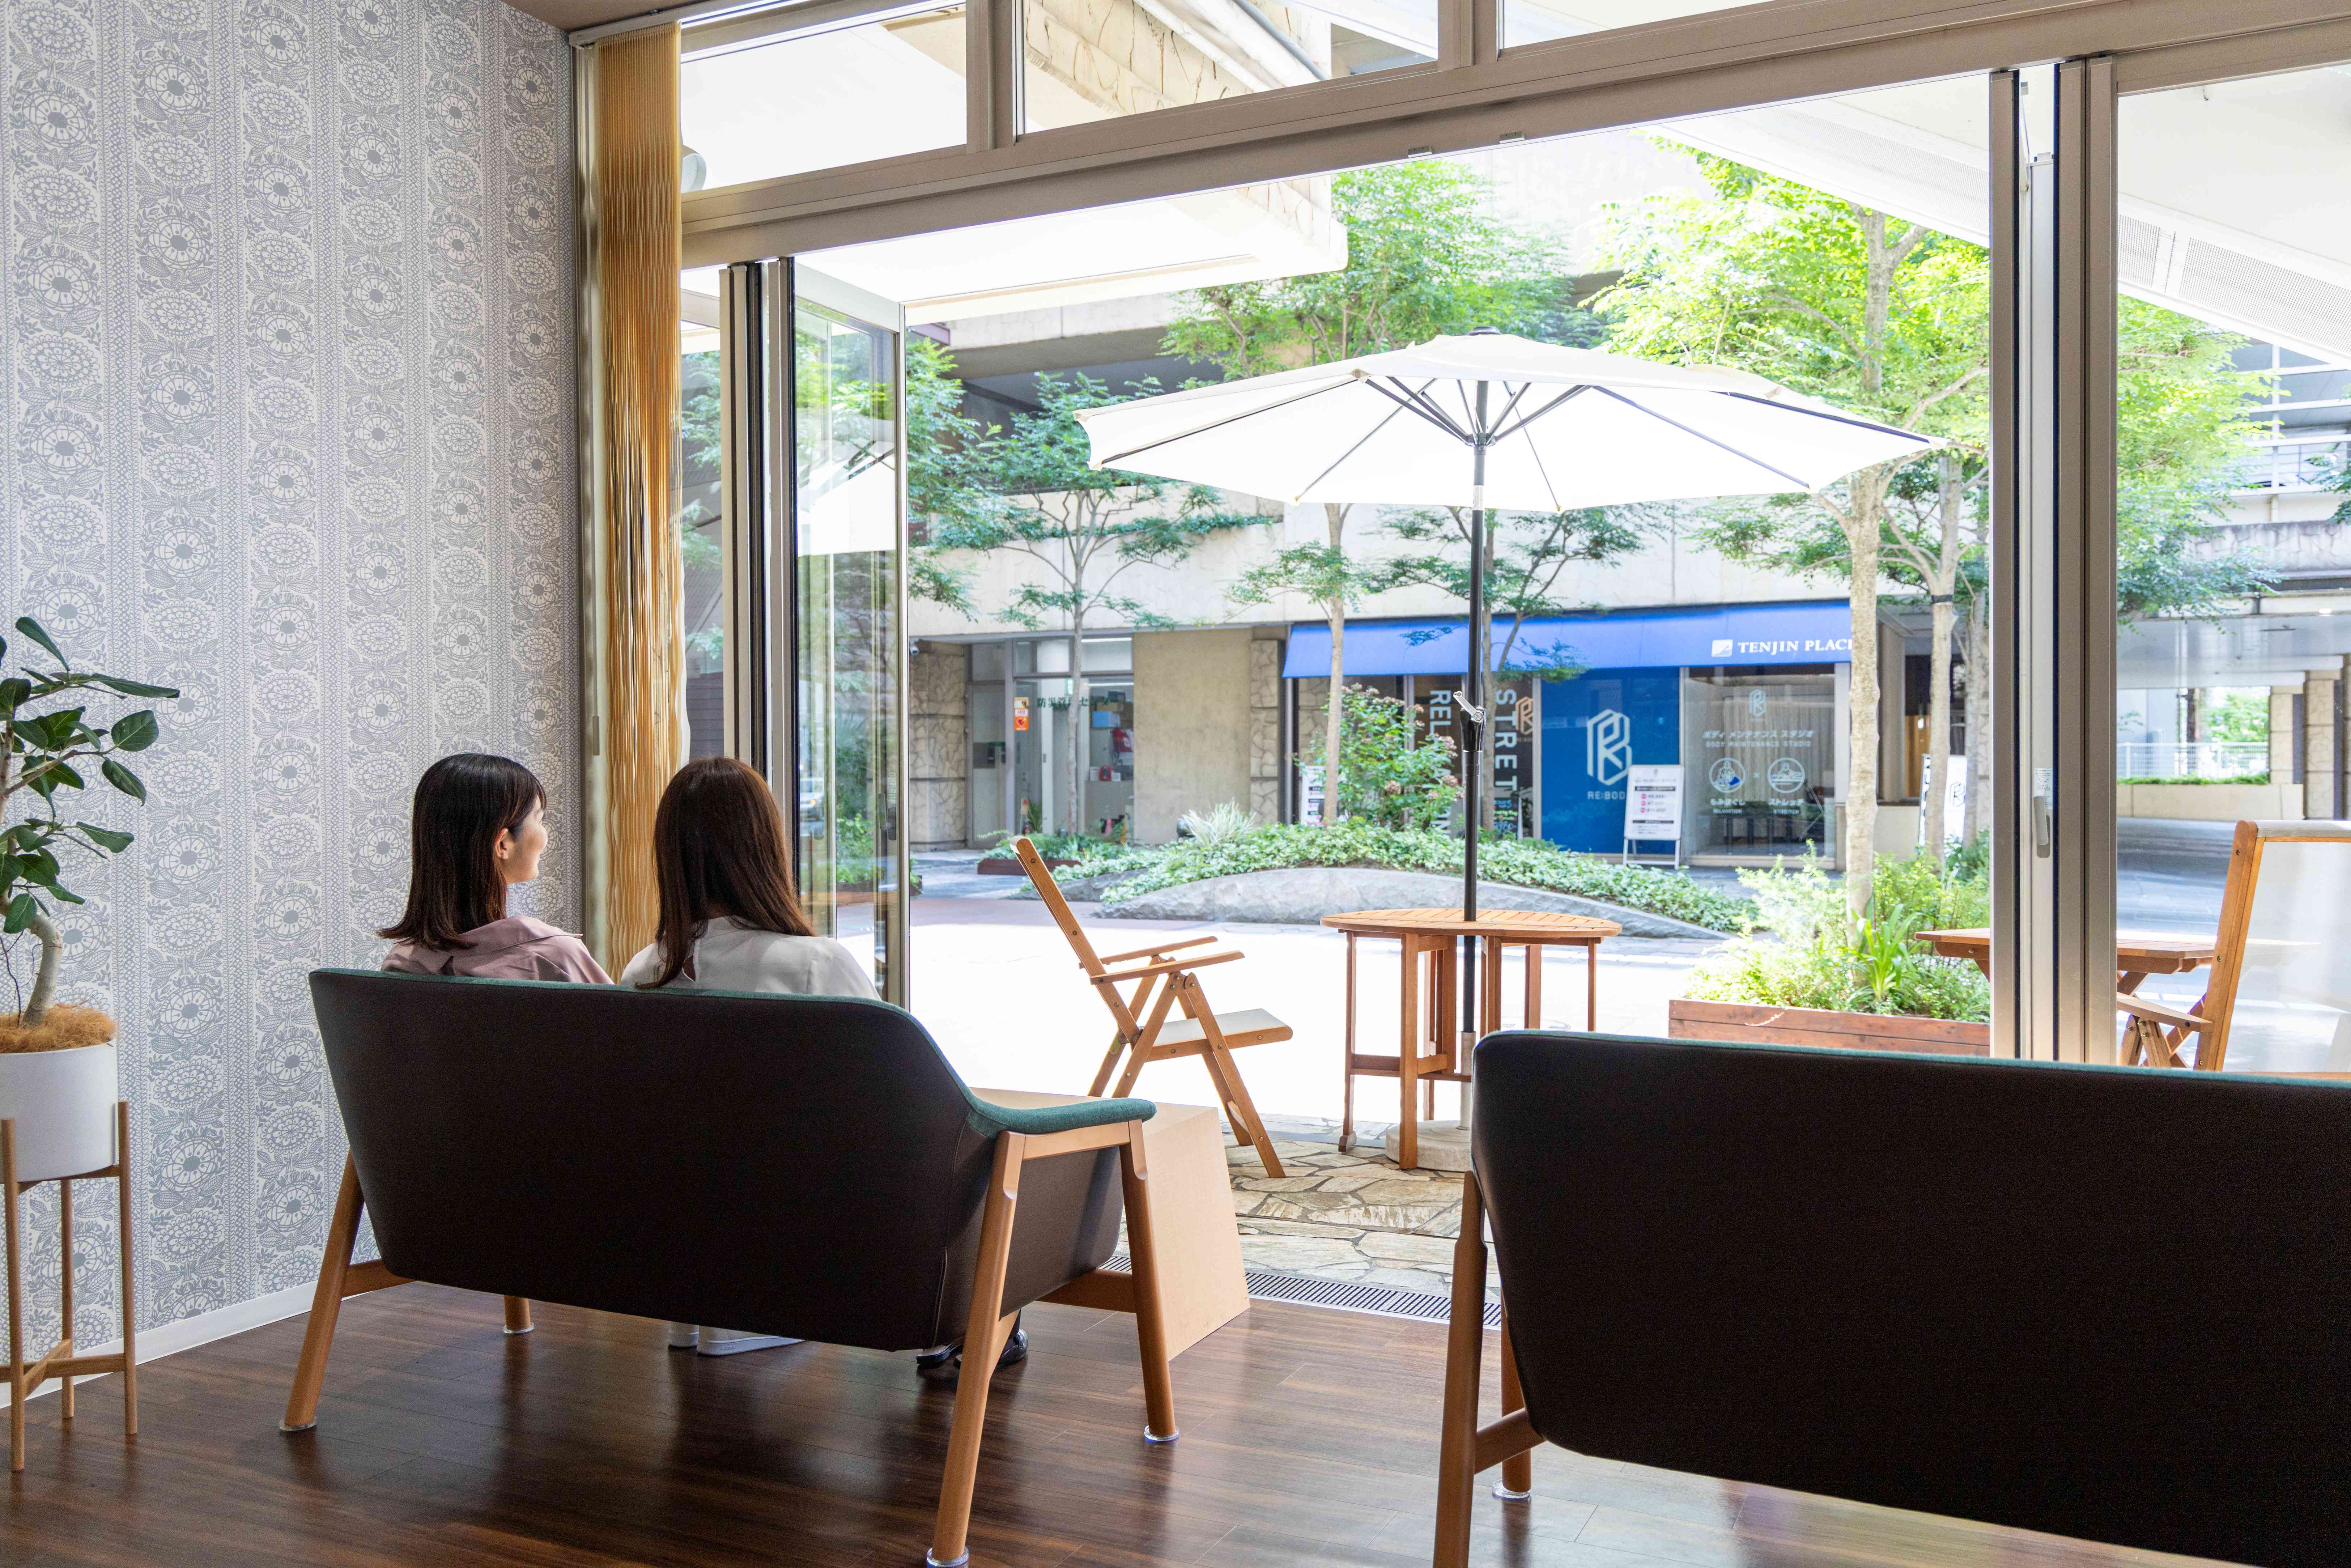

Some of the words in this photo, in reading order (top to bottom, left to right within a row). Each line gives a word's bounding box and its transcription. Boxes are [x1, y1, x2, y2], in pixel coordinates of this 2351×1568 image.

[1738, 641, 1799, 655] TENJIN
[1781, 729, 1814, 738] スタジオ
[1495, 689, 1517, 791] STRET
[1587, 791, 1626, 800] RE:BOD
